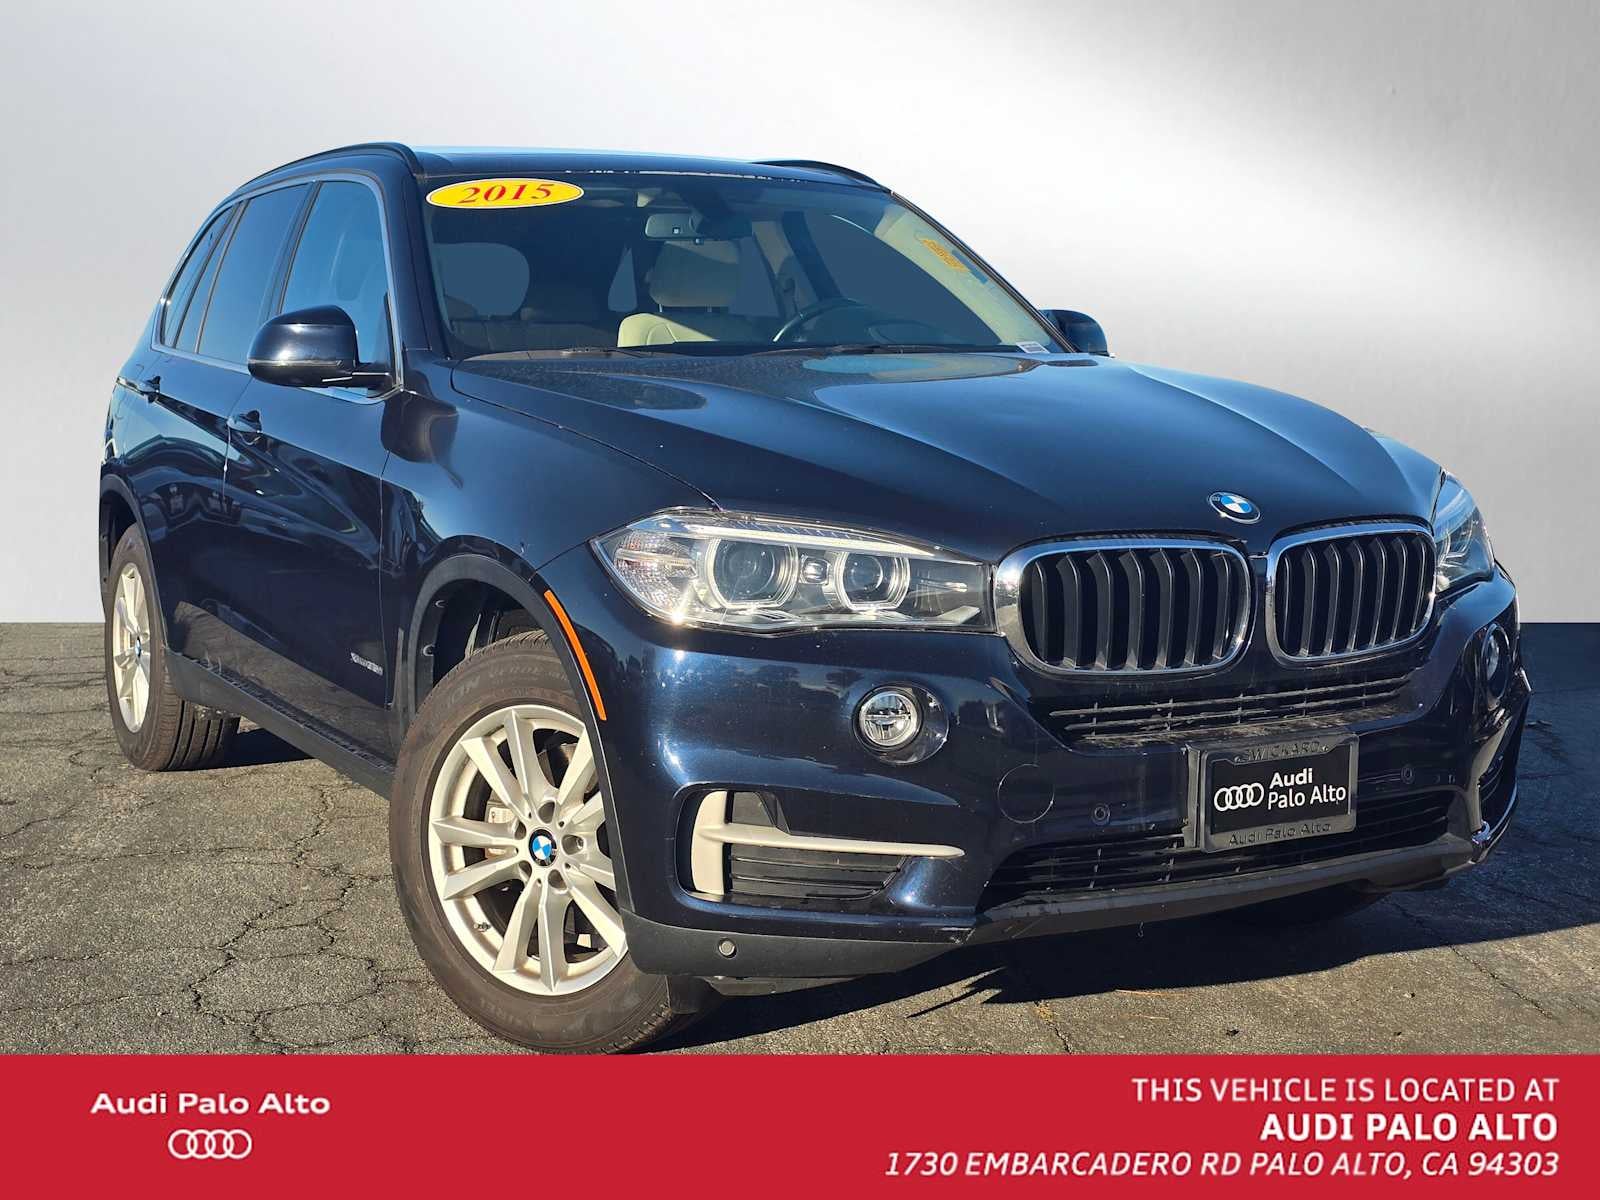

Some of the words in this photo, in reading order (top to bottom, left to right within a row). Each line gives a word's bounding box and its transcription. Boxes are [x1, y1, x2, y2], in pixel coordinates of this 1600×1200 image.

[457, 184, 554, 203] 2015
[1268, 768, 1313, 789] Audi
[1267, 790, 1306, 810] Palo
[1310, 784, 1346, 804] Alto
[1229, 831, 1261, 846] Audi
[1265, 826, 1297, 841] Palo
[1301, 822, 1332, 836] Alto
